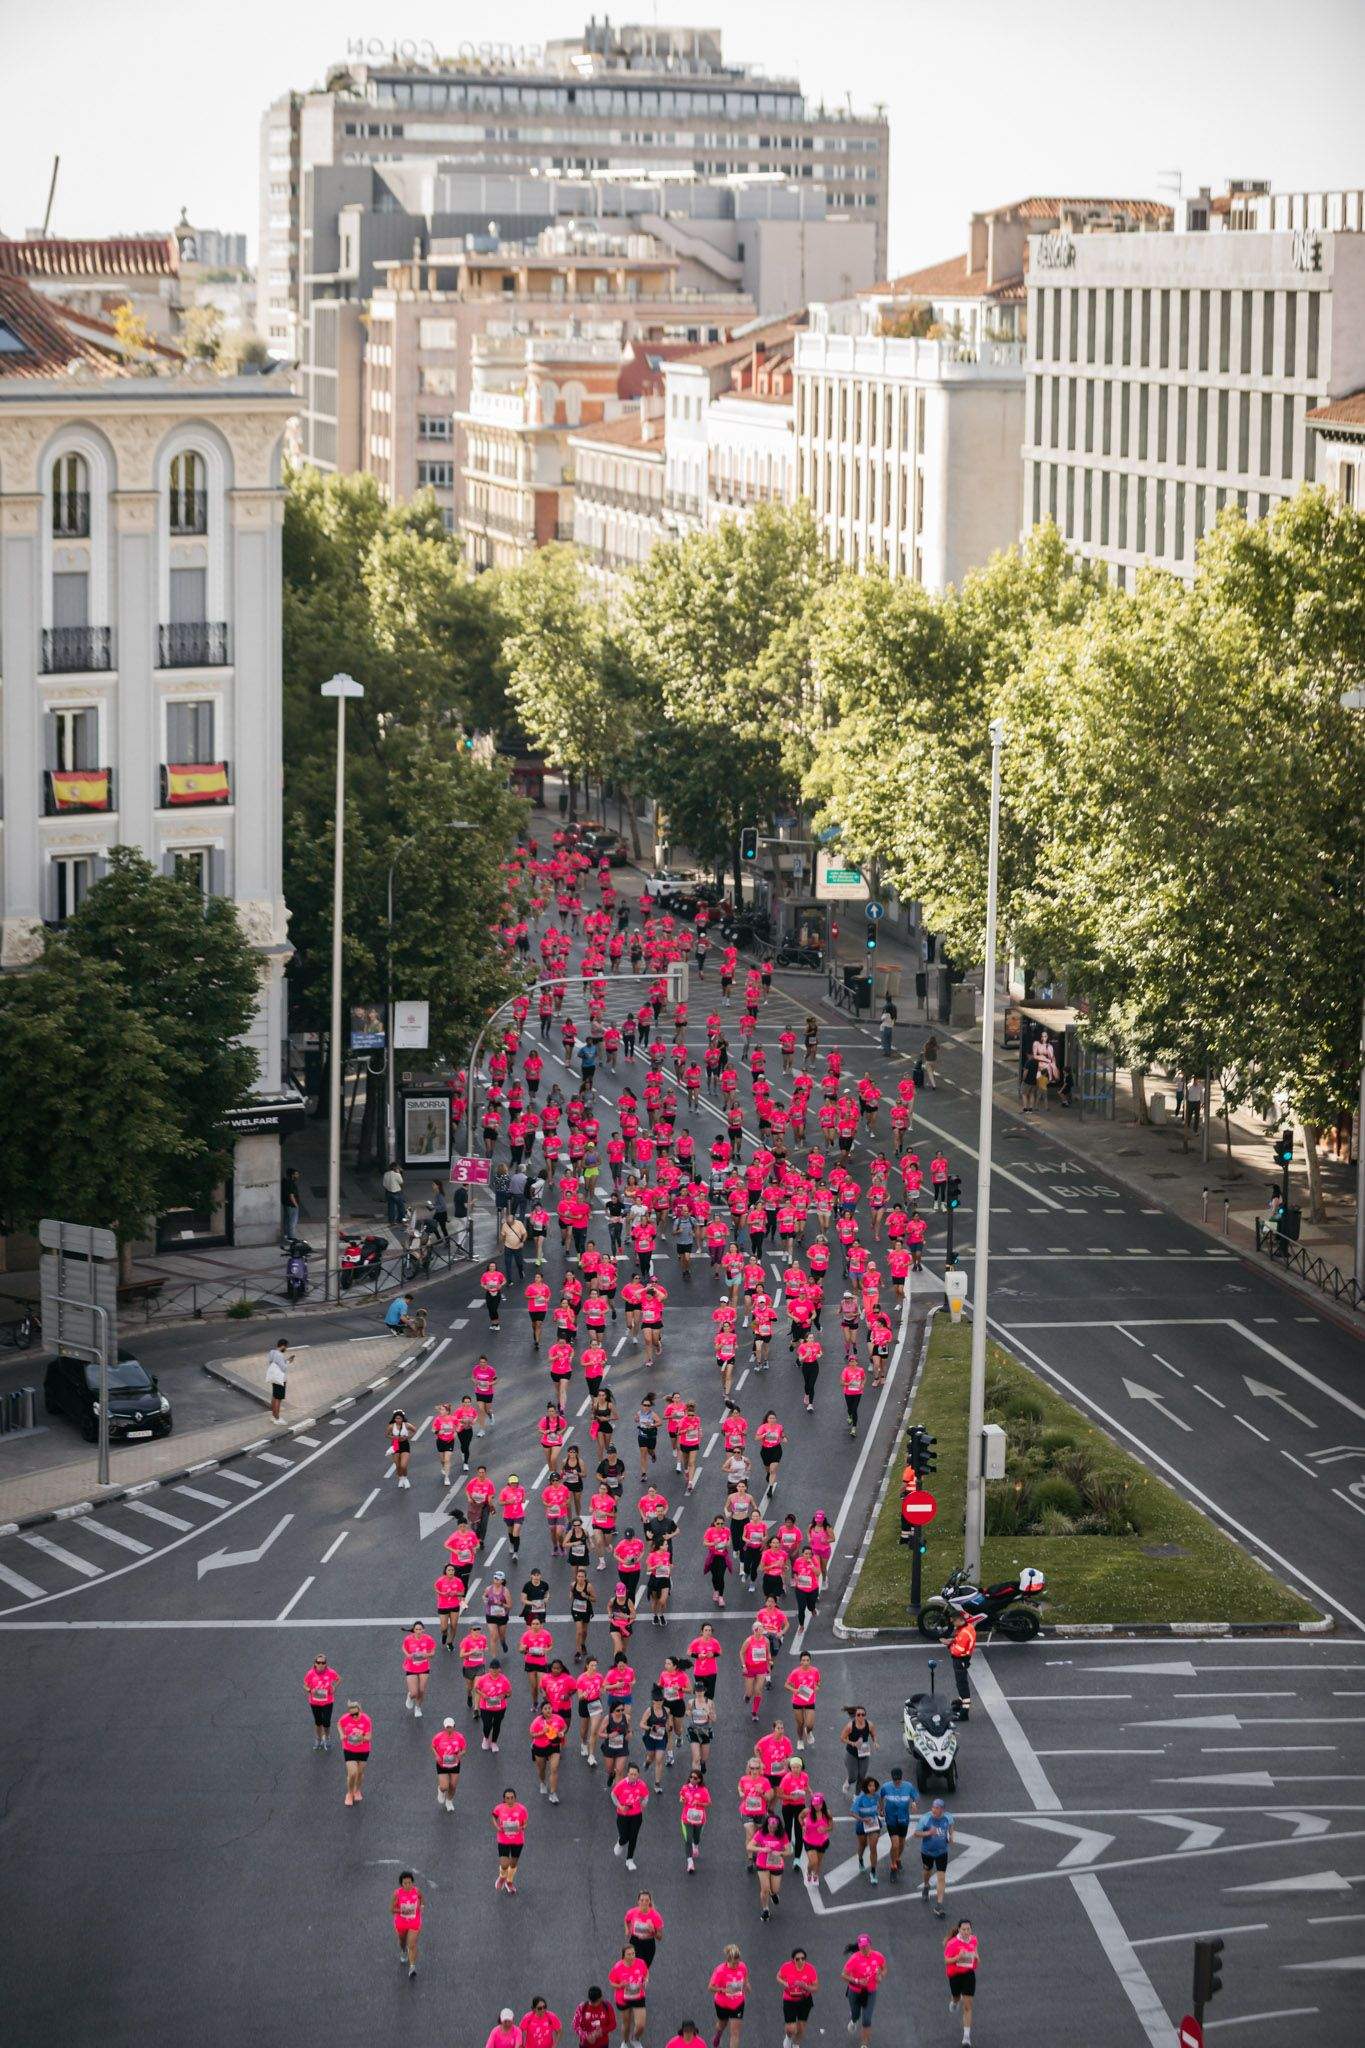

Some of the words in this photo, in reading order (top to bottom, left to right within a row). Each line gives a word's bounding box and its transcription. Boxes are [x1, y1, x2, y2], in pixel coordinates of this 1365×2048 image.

[231, 1116, 279, 1126] WELFARE
[457, 1167, 468, 1181] 3
[1010, 1162, 1087, 1174] TAXI
[1049, 1185, 1121, 1197] BUS
